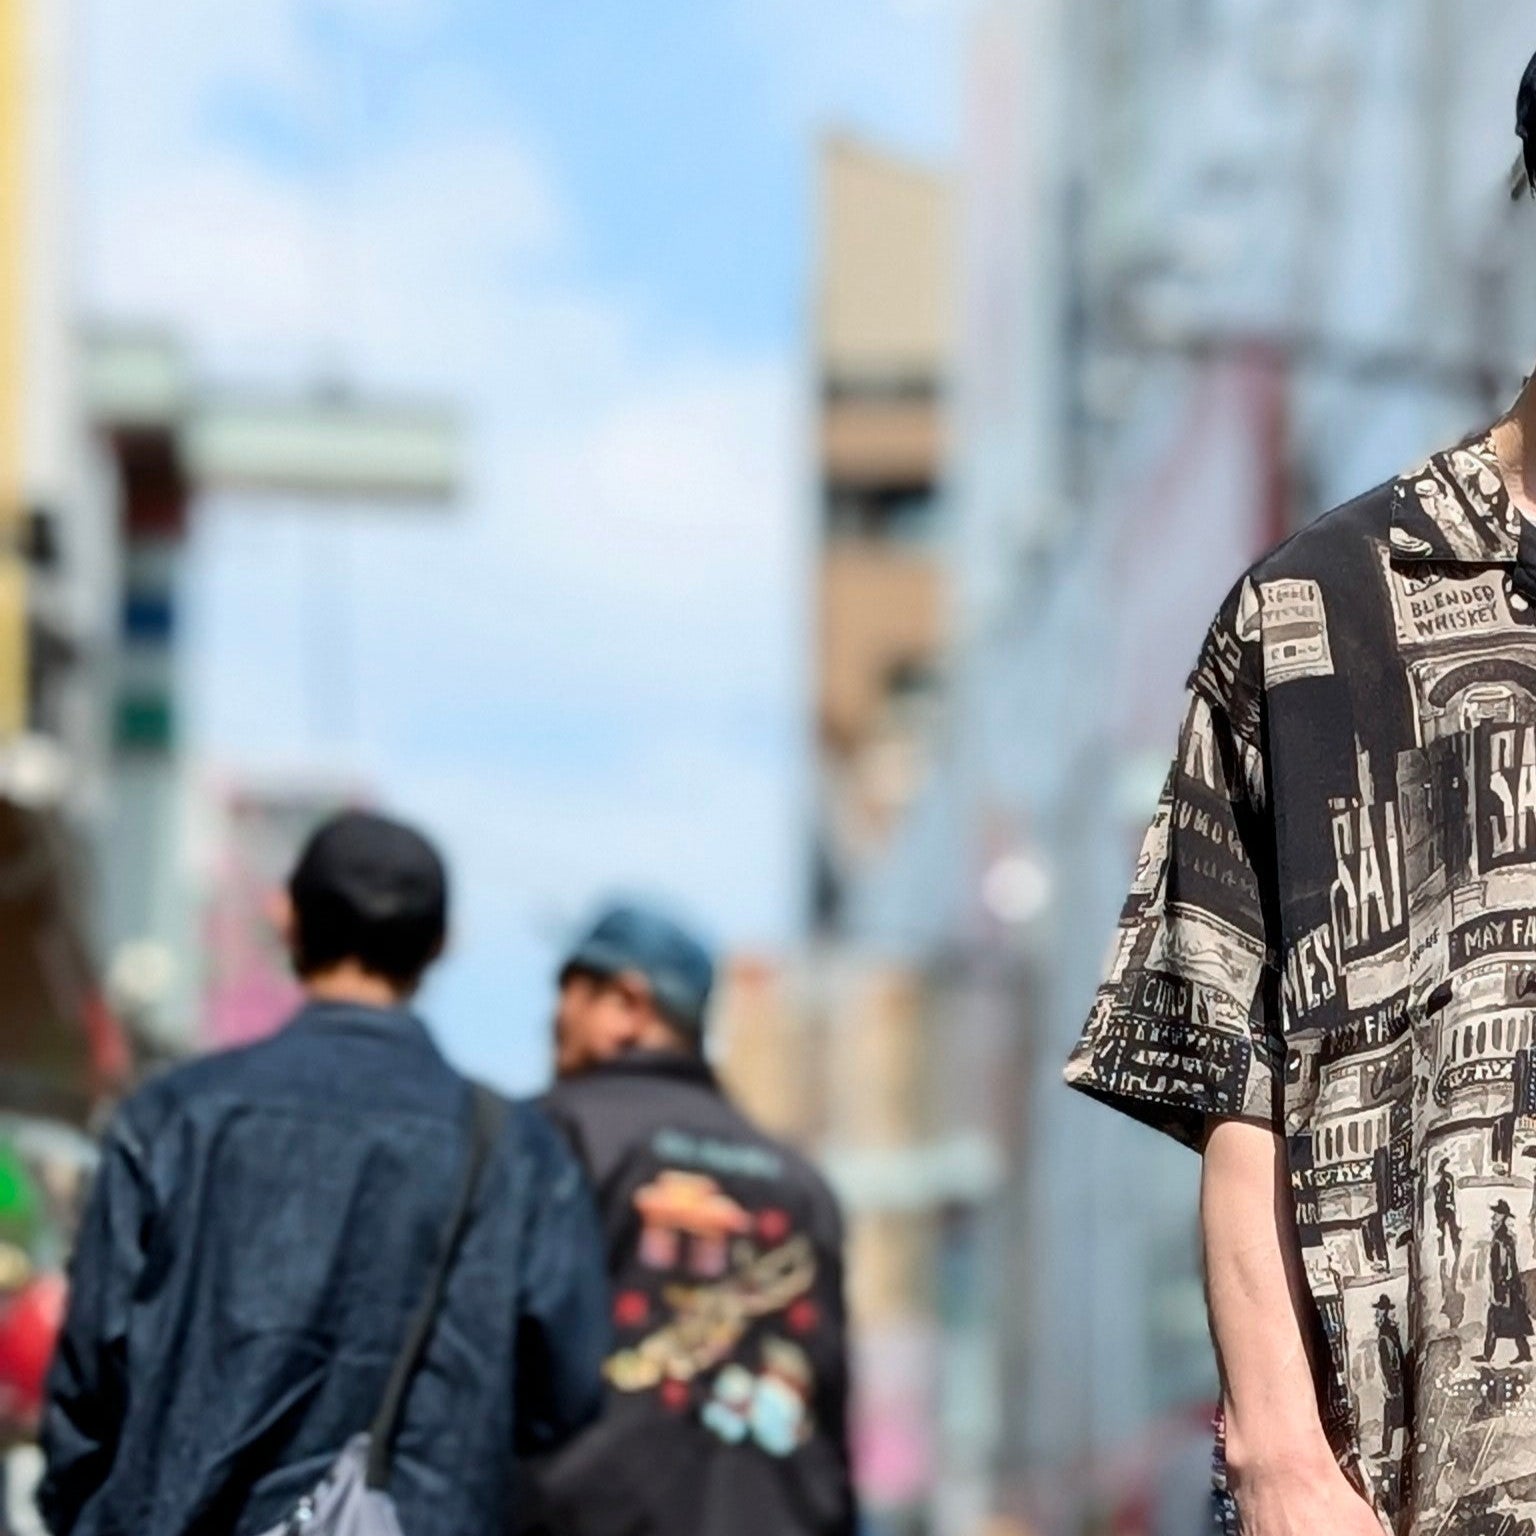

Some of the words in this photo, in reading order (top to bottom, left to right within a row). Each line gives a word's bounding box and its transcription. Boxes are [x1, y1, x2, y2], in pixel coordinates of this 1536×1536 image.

[1411, 585, 1495, 618] BLENDED
[1414, 601, 1498, 636] WHISKEY
[1464, 921, 1506, 956] MAY
